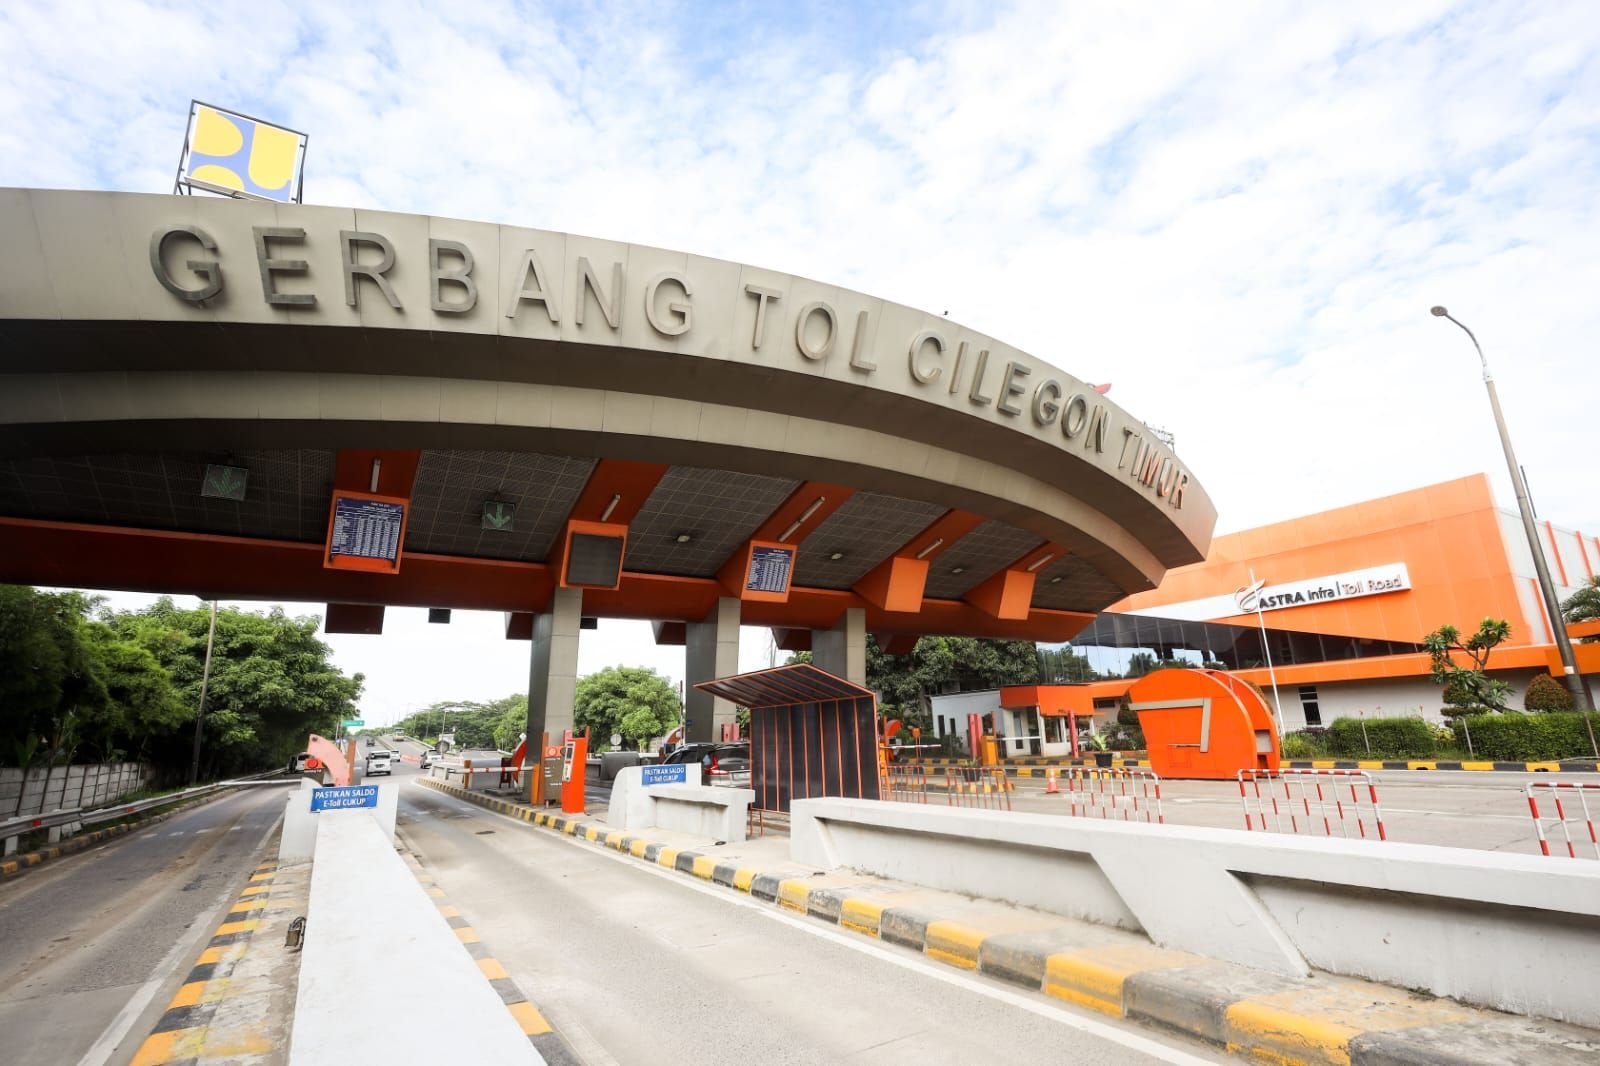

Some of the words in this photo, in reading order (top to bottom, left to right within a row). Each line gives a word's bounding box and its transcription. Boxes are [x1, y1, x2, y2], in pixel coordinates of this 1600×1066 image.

[150, 224, 692, 338] GERBANG
[745, 283, 877, 373] TOL
[909, 329, 1112, 454] CILEGON
[1117, 425, 1189, 510] TIMUR
[1259, 591, 1305, 608] ASTRA
[1307, 586, 1336, 601] Infra
[1342, 580, 1364, 595] Toll
[1367, 573, 1403, 592] Road
[315, 790, 351, 799] PASTIKAN
[351, 788, 375, 797] SALDO
[323, 799, 341, 808] E-Toll
[342, 798, 367, 806] CUKUP
